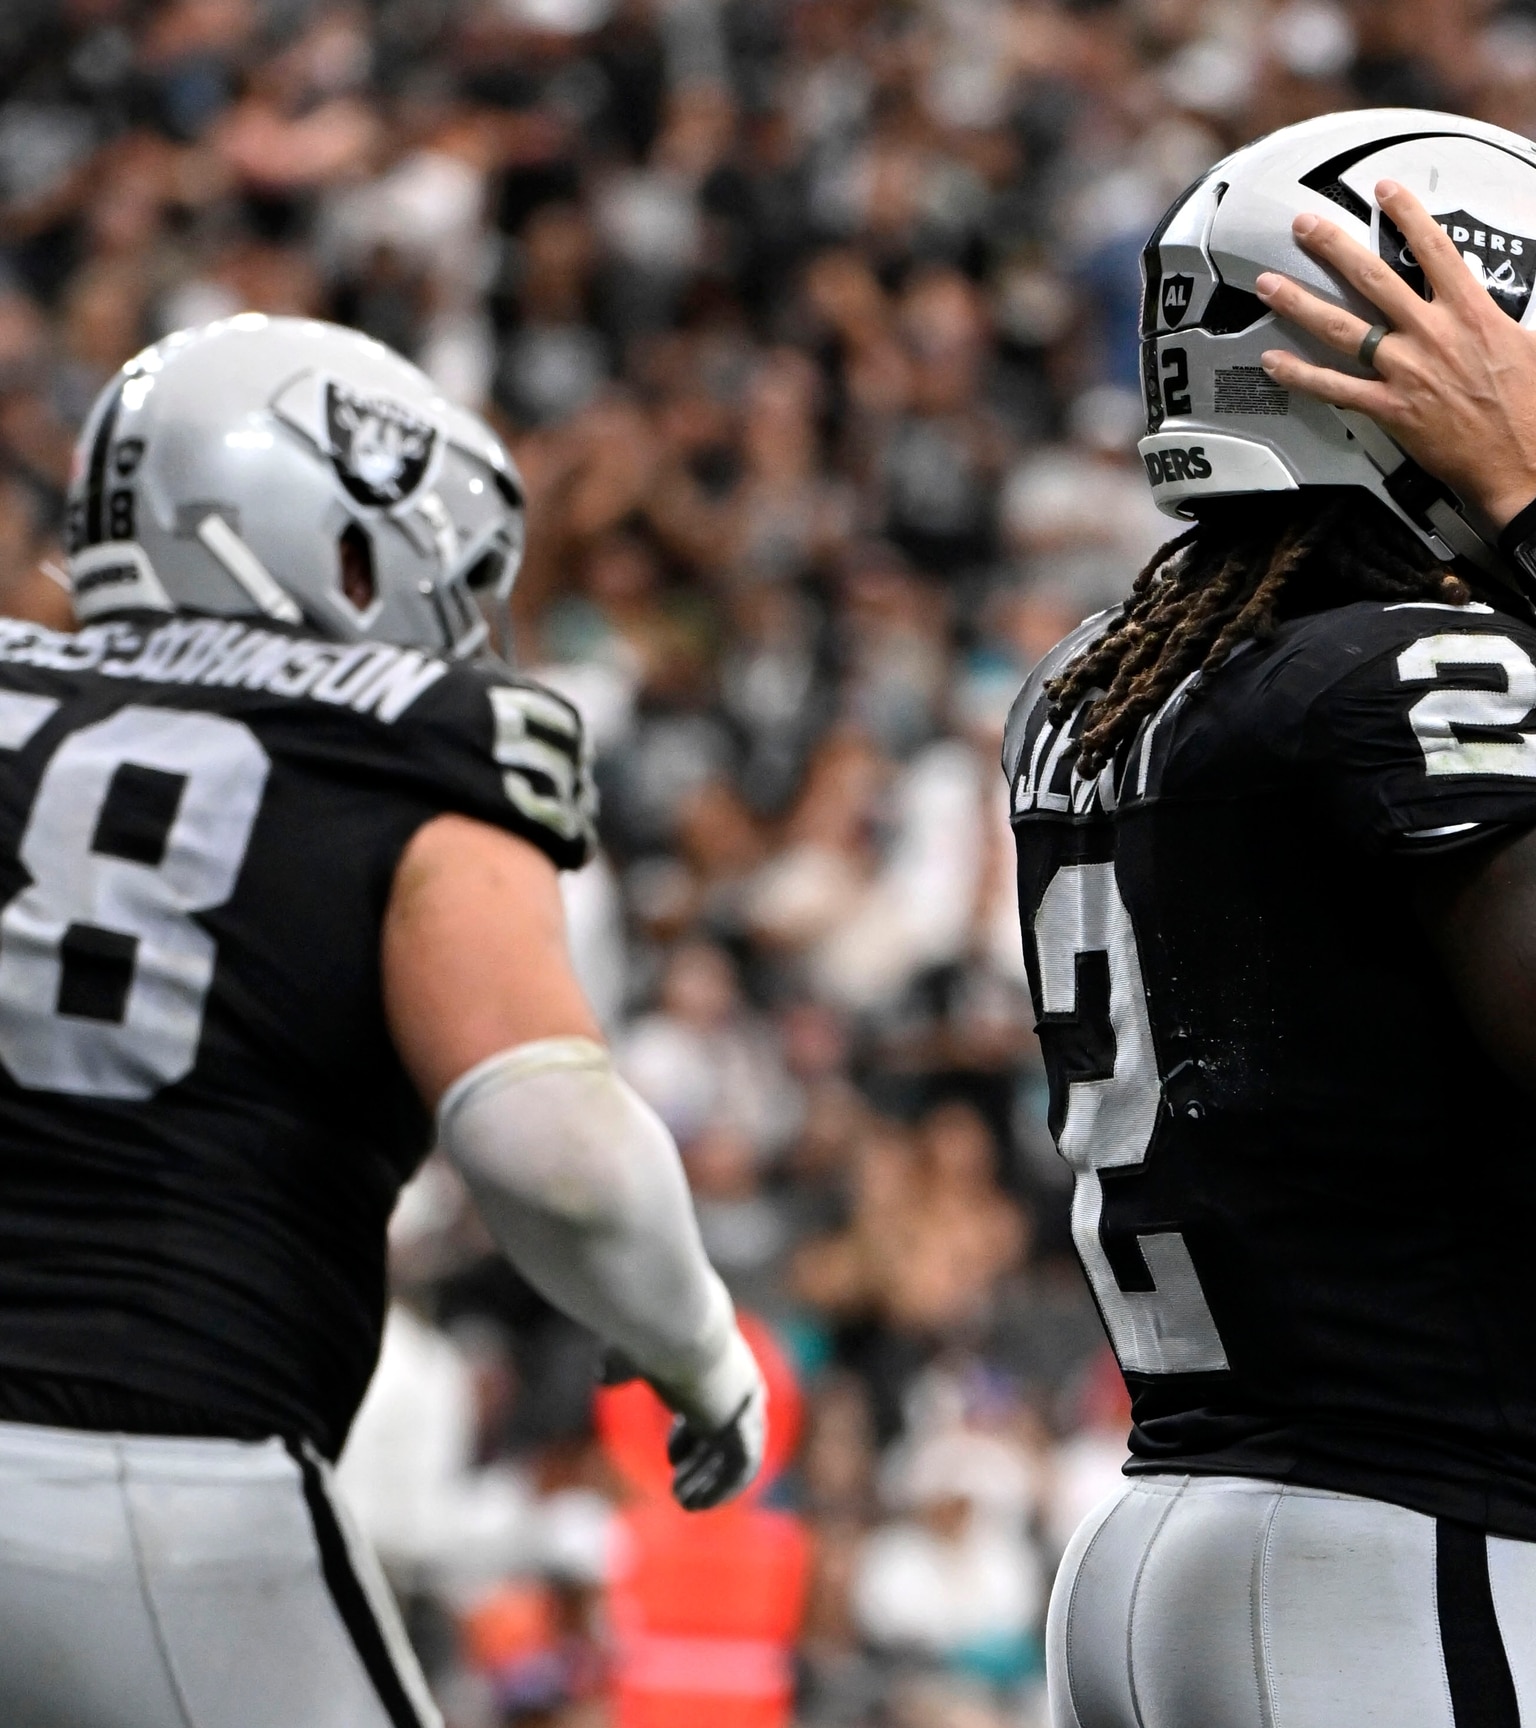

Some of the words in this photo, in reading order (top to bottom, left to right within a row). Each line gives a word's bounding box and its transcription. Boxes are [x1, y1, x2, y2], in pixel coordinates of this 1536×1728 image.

[1440, 223, 1524, 256] IDERS
[1164, 285, 1187, 307] AL
[1161, 347, 1193, 417] 2
[1143, 446, 1212, 487] DERS
[0, 689, 273, 1101] 8
[1034, 861, 1231, 1375] 2
